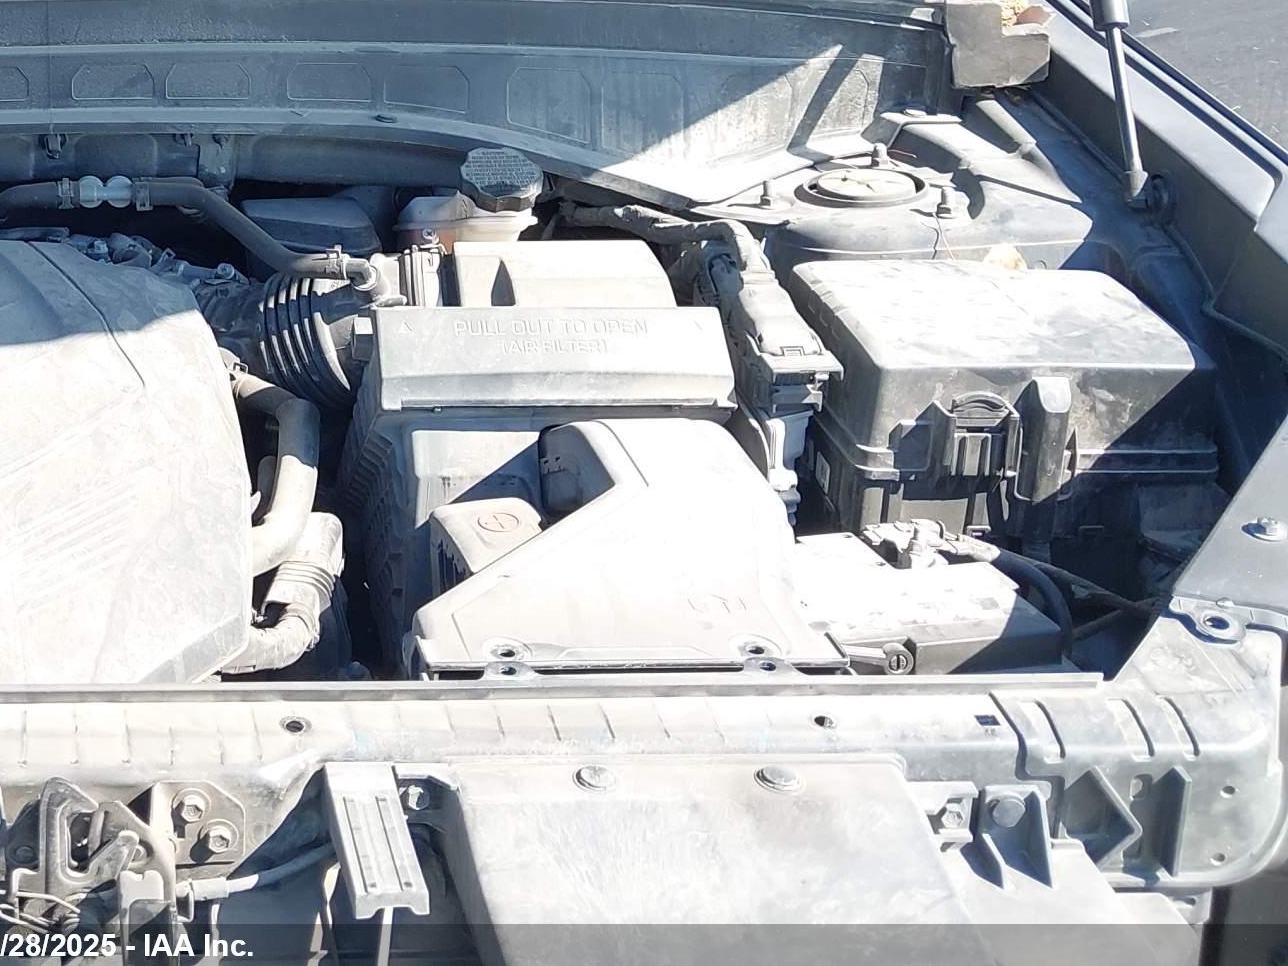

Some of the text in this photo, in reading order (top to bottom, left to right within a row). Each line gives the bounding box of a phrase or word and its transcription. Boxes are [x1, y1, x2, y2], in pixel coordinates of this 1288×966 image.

[454, 318, 649, 336] PULL OUT TO OPEN
